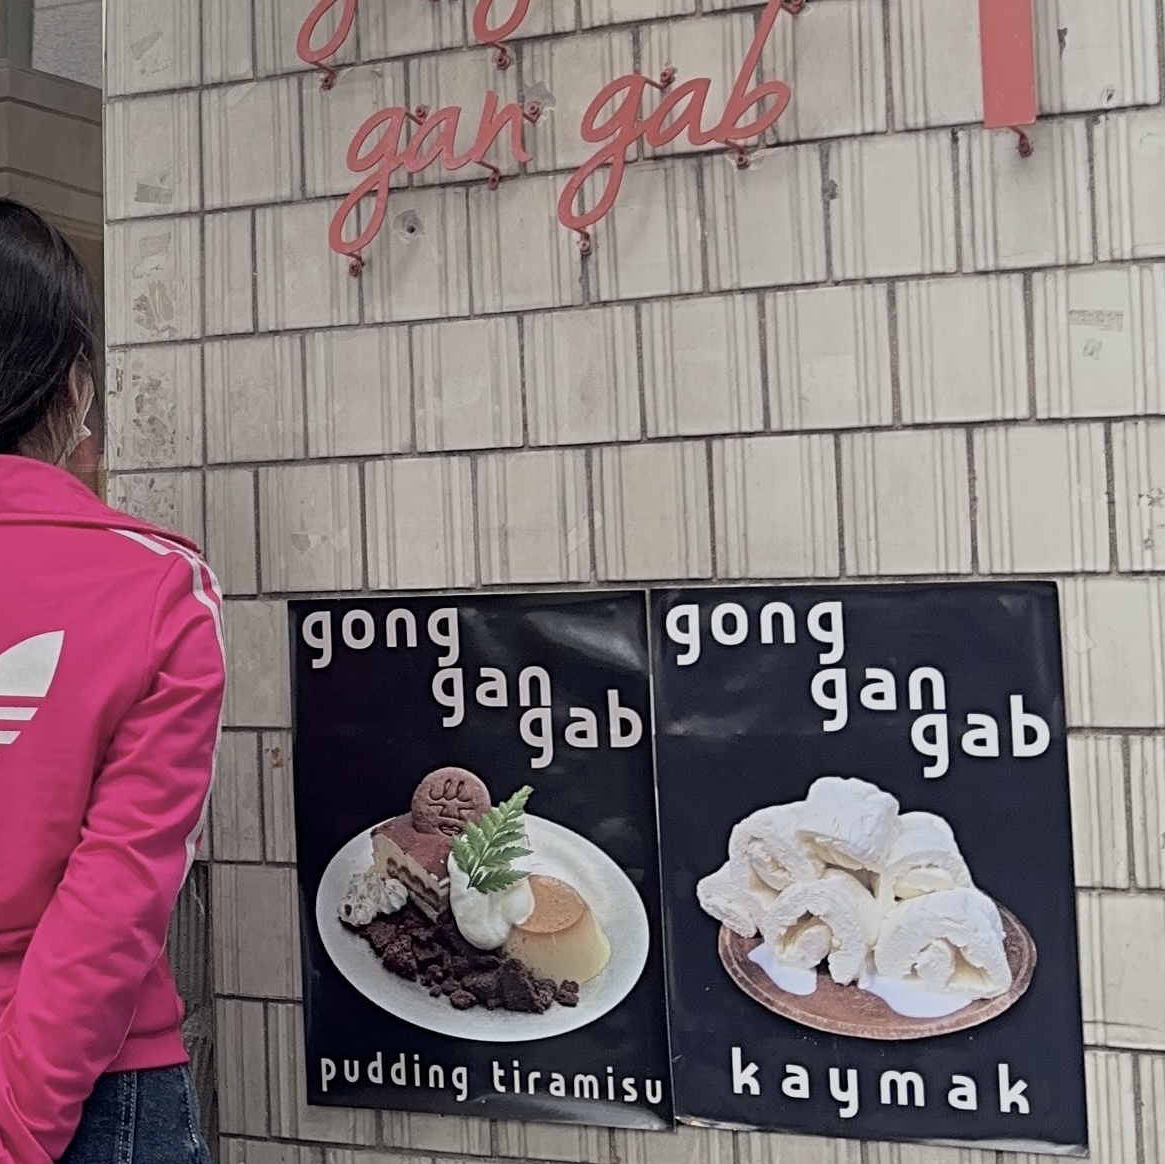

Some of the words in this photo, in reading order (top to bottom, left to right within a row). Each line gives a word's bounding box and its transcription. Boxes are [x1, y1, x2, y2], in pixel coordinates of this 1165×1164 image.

[328, 90, 533, 254] gan
[557, 0, 792, 230] gab
[301, 606, 461, 669] gong
[665, 601, 846, 666] gong
[431, 665, 552, 728] gan
[519, 688, 643, 769] gab
[810, 666, 947, 732] gan
[910, 694, 1051, 779] gab
[319, 1051, 469, 1102] pudding
[491, 1060, 663, 1105] tiramisu
[731, 1046, 1031, 1119] kaymak
